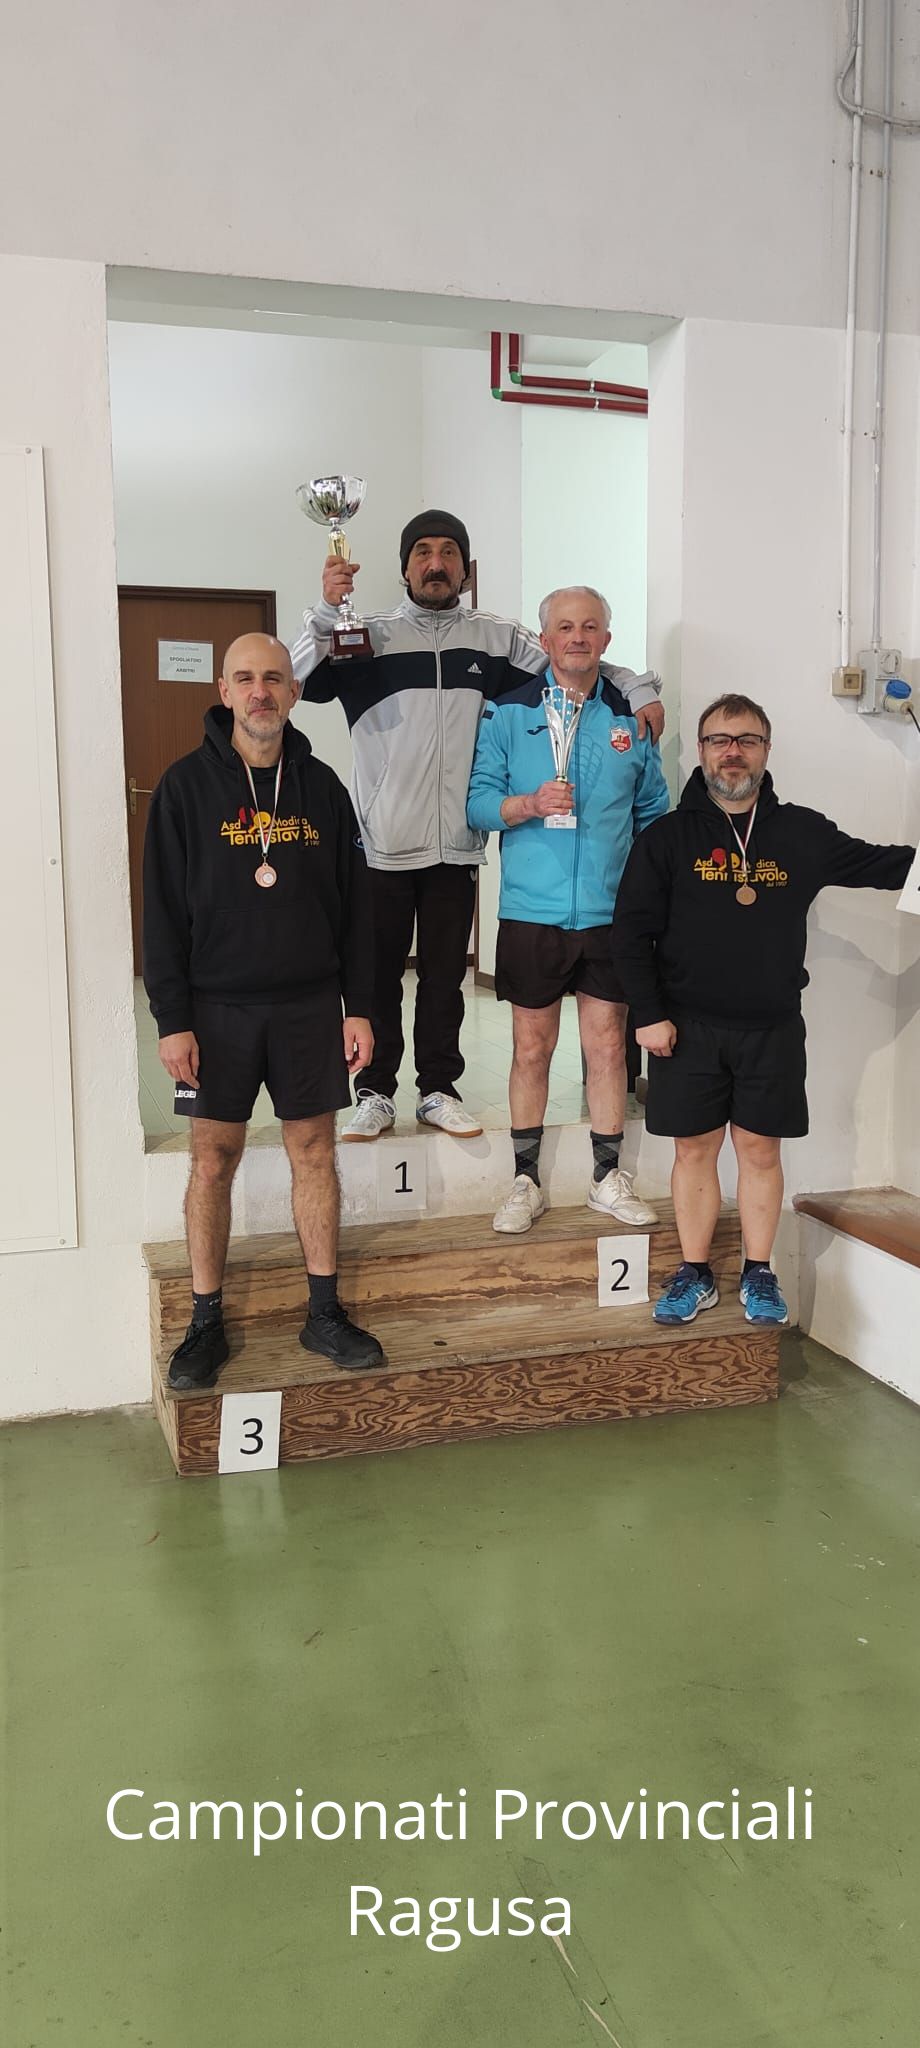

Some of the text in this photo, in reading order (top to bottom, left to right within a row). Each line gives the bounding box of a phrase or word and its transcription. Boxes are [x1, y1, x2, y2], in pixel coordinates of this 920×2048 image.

[221, 819, 241, 831] Asd
[222, 826, 319, 845] Tennstavolo
[695, 857, 776, 869] Asd Mdica
[174, 1089, 197, 1099] LEGE
[394, 1160, 414, 1194] 1
[610, 1258, 631, 1292] 2
[239, 1417, 264, 1455] 3
